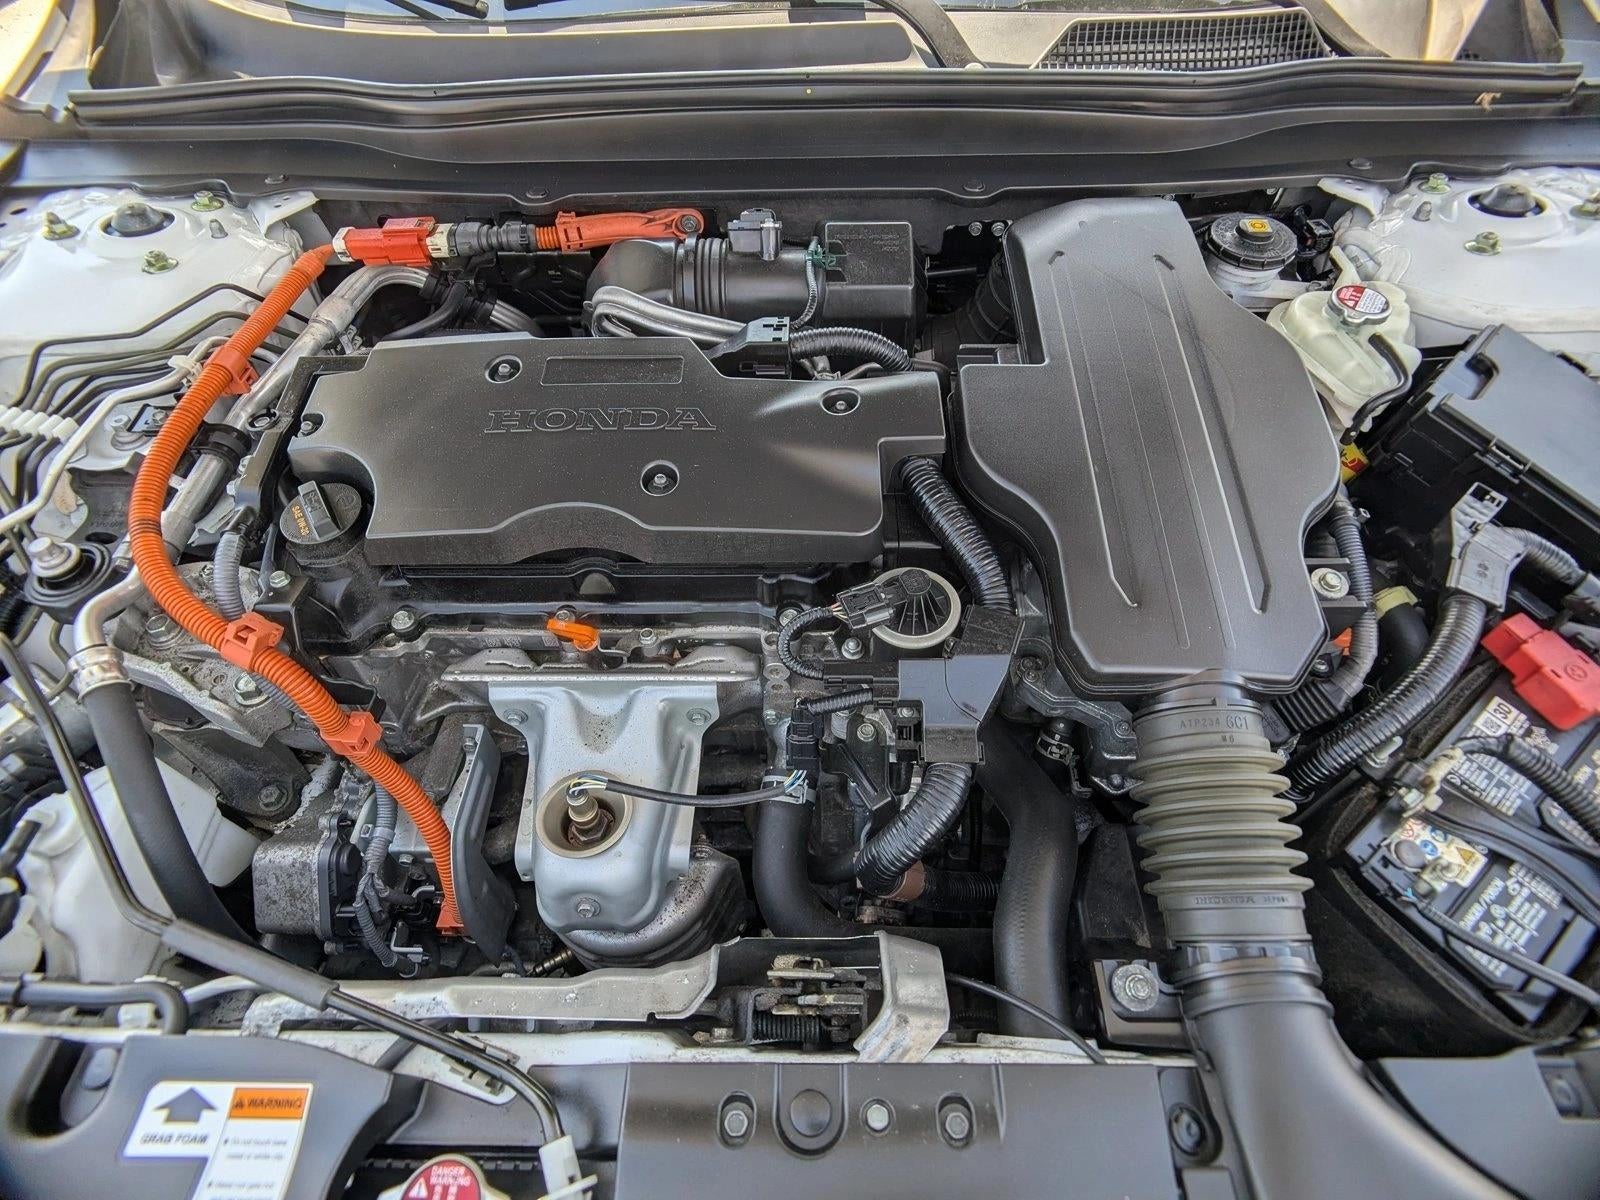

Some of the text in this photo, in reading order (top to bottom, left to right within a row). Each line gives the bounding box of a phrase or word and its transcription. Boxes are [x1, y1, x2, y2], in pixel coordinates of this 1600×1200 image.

[484, 408, 716, 433] HONDA
[247, 1097, 303, 1110] WARNING
[431, 1165, 466, 1176] DANGER
[430, 1175, 472, 1188] WARNING
